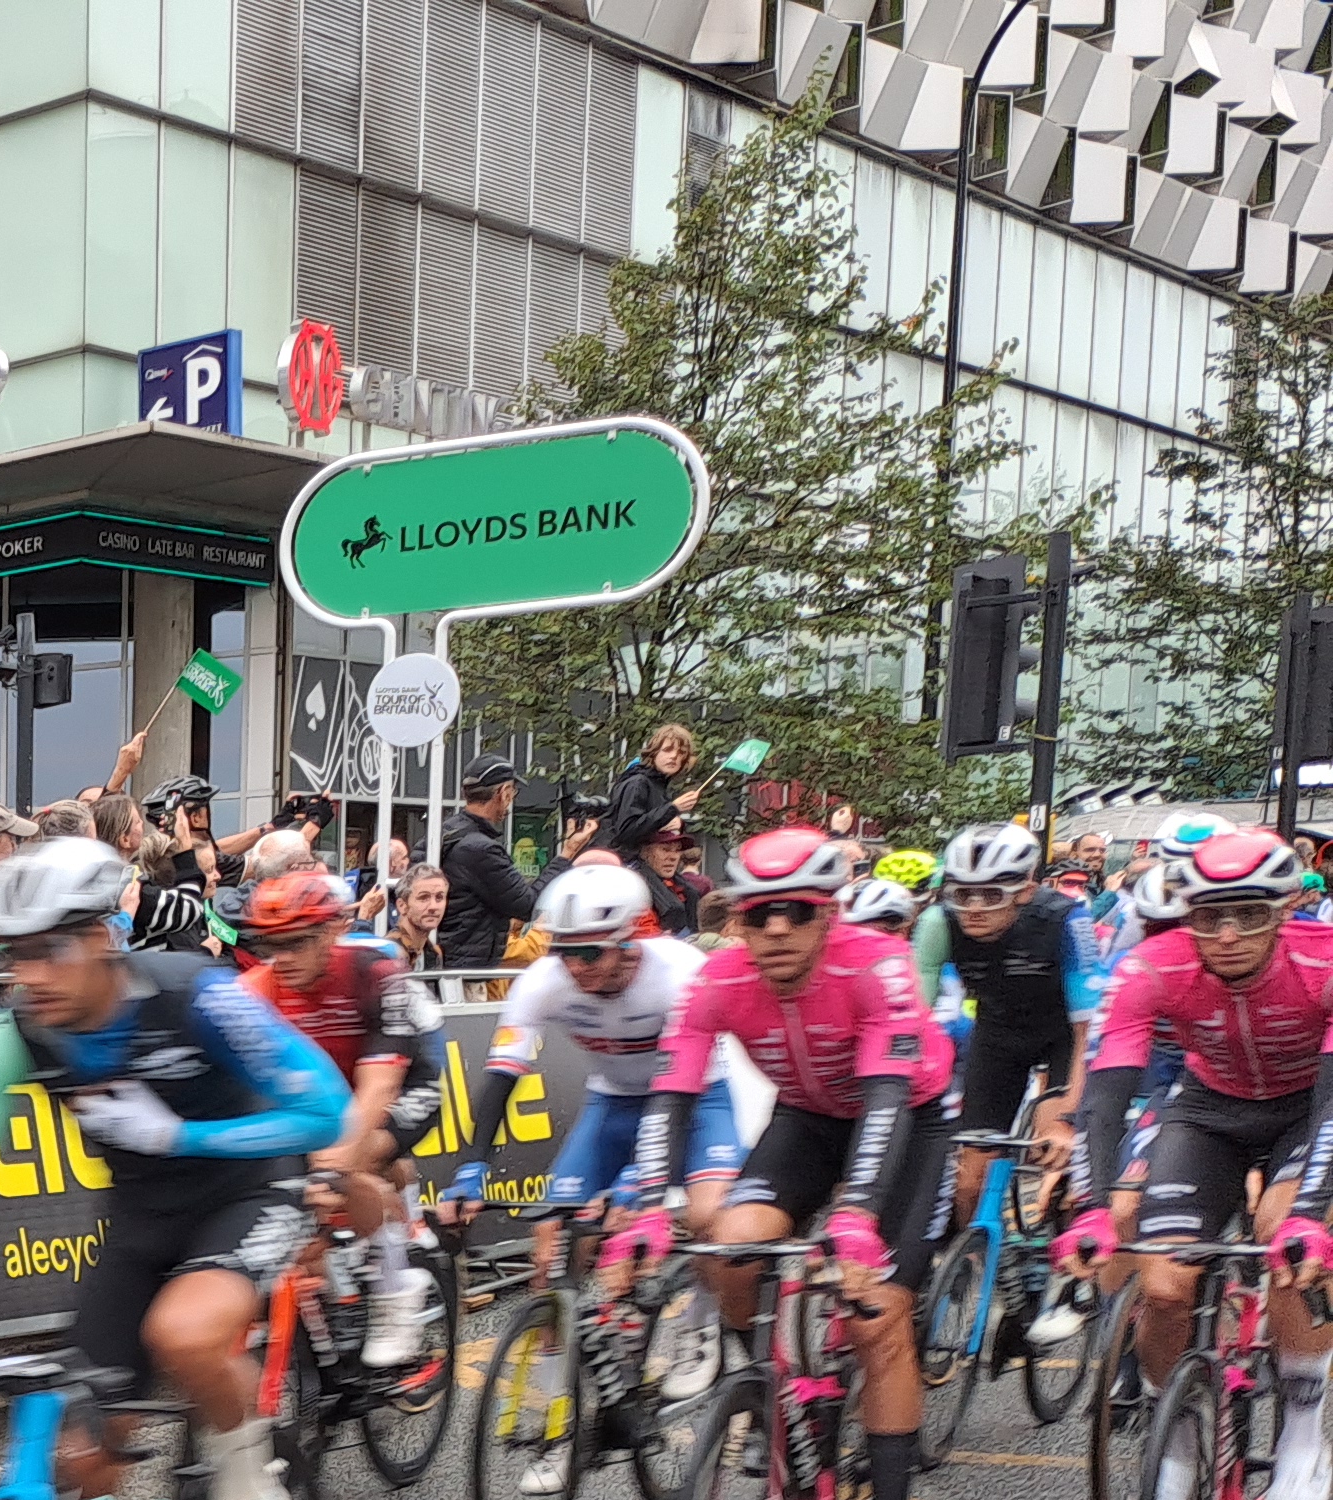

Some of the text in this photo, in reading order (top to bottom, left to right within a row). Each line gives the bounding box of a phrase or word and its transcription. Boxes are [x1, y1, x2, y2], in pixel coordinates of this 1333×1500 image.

[186, 356, 221, 425] P
[98, 531, 267, 569] CASINO LATE BAR RESTAURANT
[399, 499, 637, 552] LLOYDS BANK
